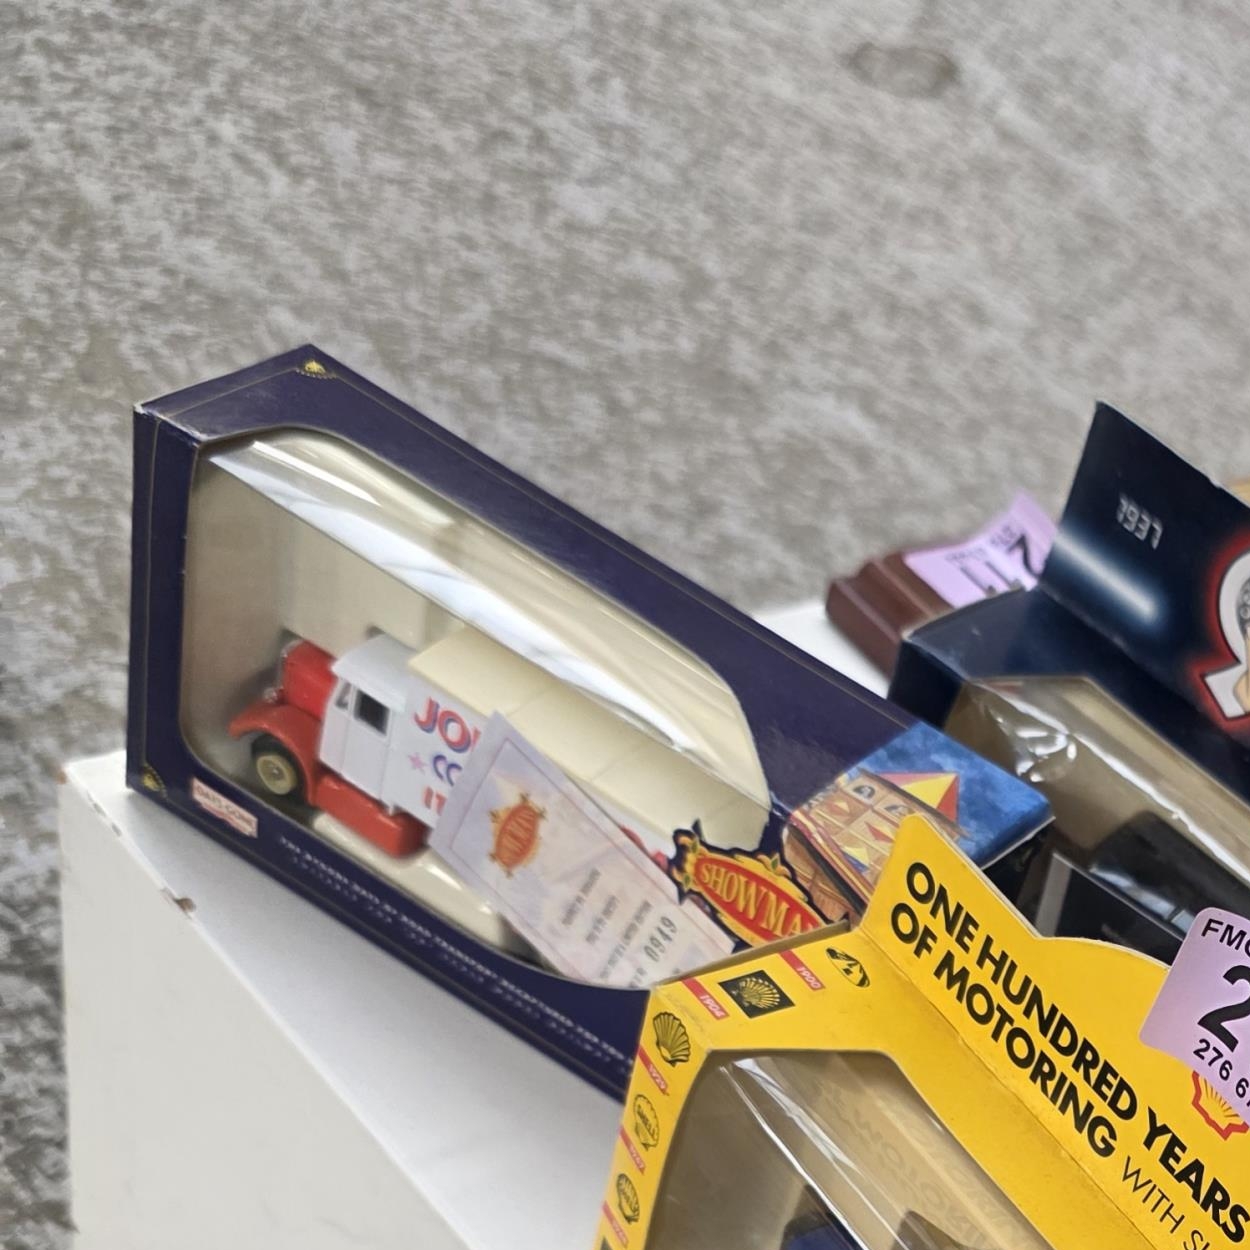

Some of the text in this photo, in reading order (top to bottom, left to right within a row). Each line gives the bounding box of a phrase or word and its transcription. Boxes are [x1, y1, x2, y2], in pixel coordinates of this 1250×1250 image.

[1117, 494, 1163, 550] 1937
[797, 966, 821, 990] 1900
[906, 862, 979, 952] ONE
[976, 934, 1138, 1121] HUNDRED
[891, 902, 936, 959] OF
[933, 950, 1119, 1158] MOTORING
[1121, 1155, 1185, 1234] WITH
[1193, 1038, 1233, 1081] 276
